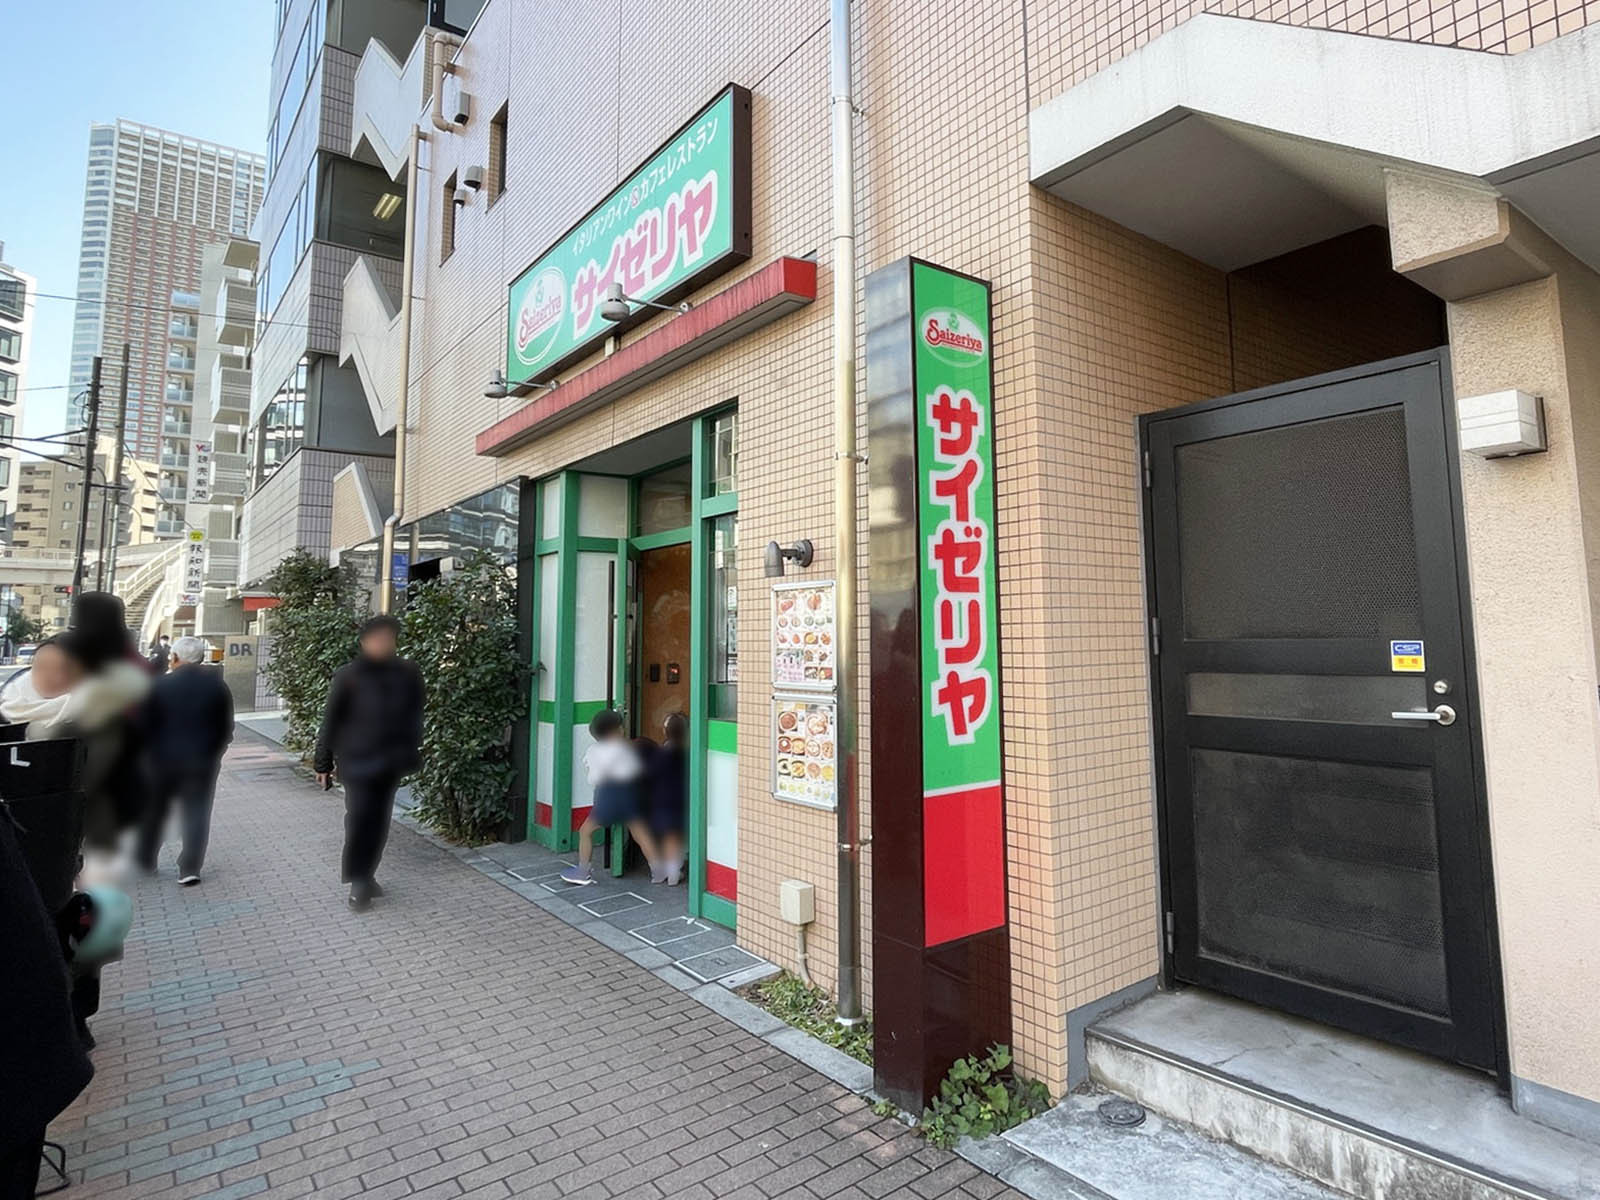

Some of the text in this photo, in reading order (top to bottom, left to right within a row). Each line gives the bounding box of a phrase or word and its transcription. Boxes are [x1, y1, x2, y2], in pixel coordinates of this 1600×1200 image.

[571, 173, 716, 337] サイゼリヤ
[925, 318, 983, 353] Saizeriya
[929, 389, 991, 740] サイゼリヤ
[230, 643, 253, 656] DR
